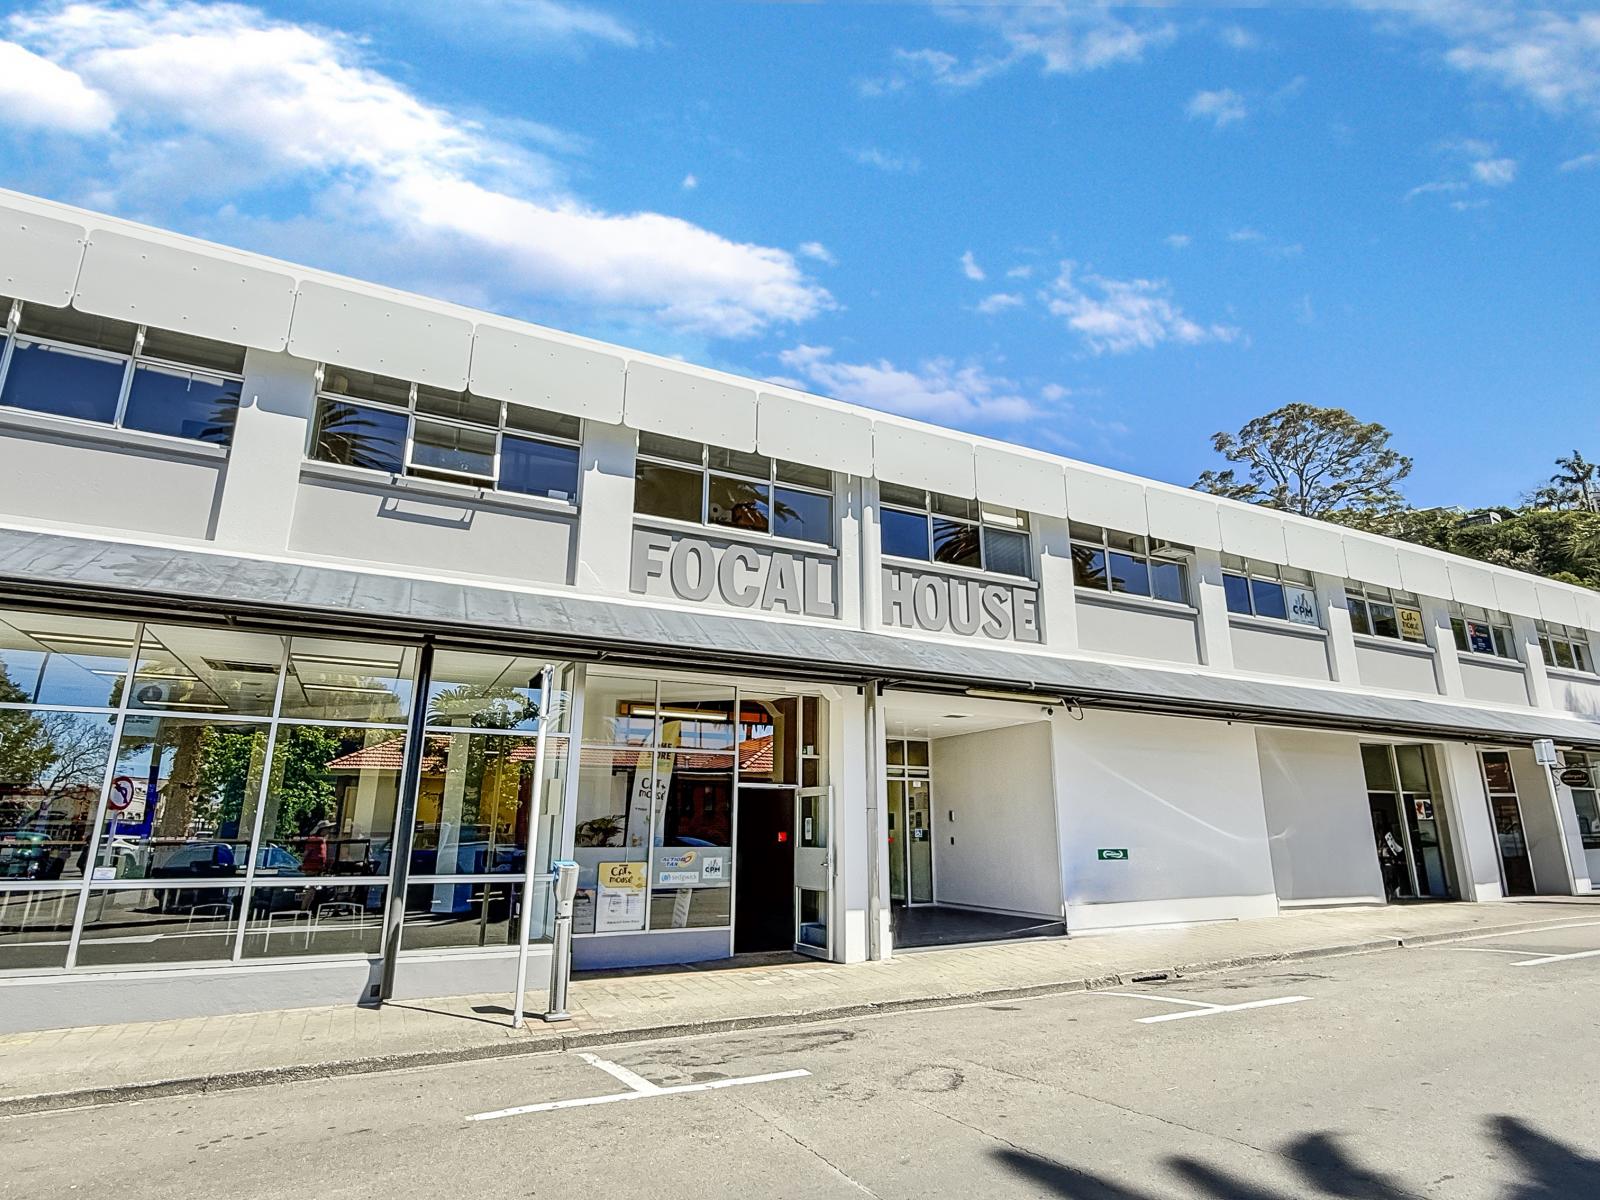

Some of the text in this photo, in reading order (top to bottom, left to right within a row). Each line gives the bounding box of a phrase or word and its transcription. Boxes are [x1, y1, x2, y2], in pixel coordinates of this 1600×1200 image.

[629, 528, 1039, 642] FOCAL HOUSE
[1293, 604, 1313, 619] CPM
[704, 866, 721, 874] CPM
